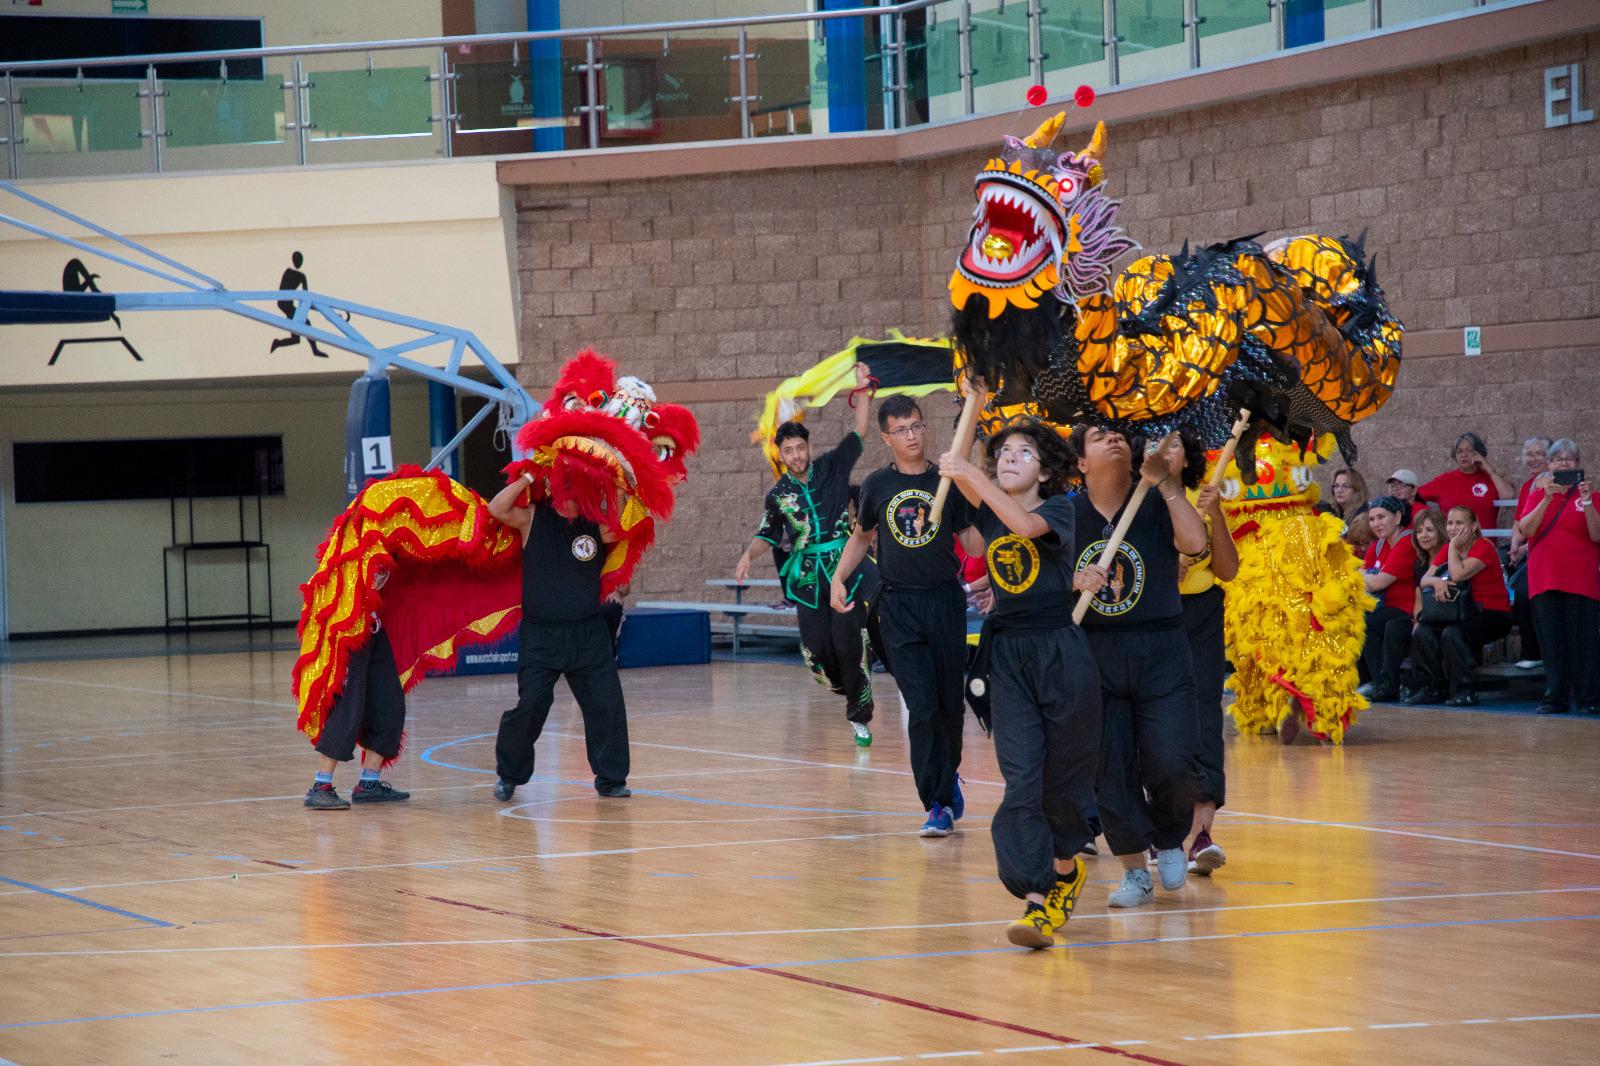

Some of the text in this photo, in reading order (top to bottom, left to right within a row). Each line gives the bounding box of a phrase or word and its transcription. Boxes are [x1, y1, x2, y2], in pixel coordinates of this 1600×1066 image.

[1544, 64, 1594, 128] EL
[370, 443, 386, 470] 1
[1133, 561, 1143, 594] CANTON
